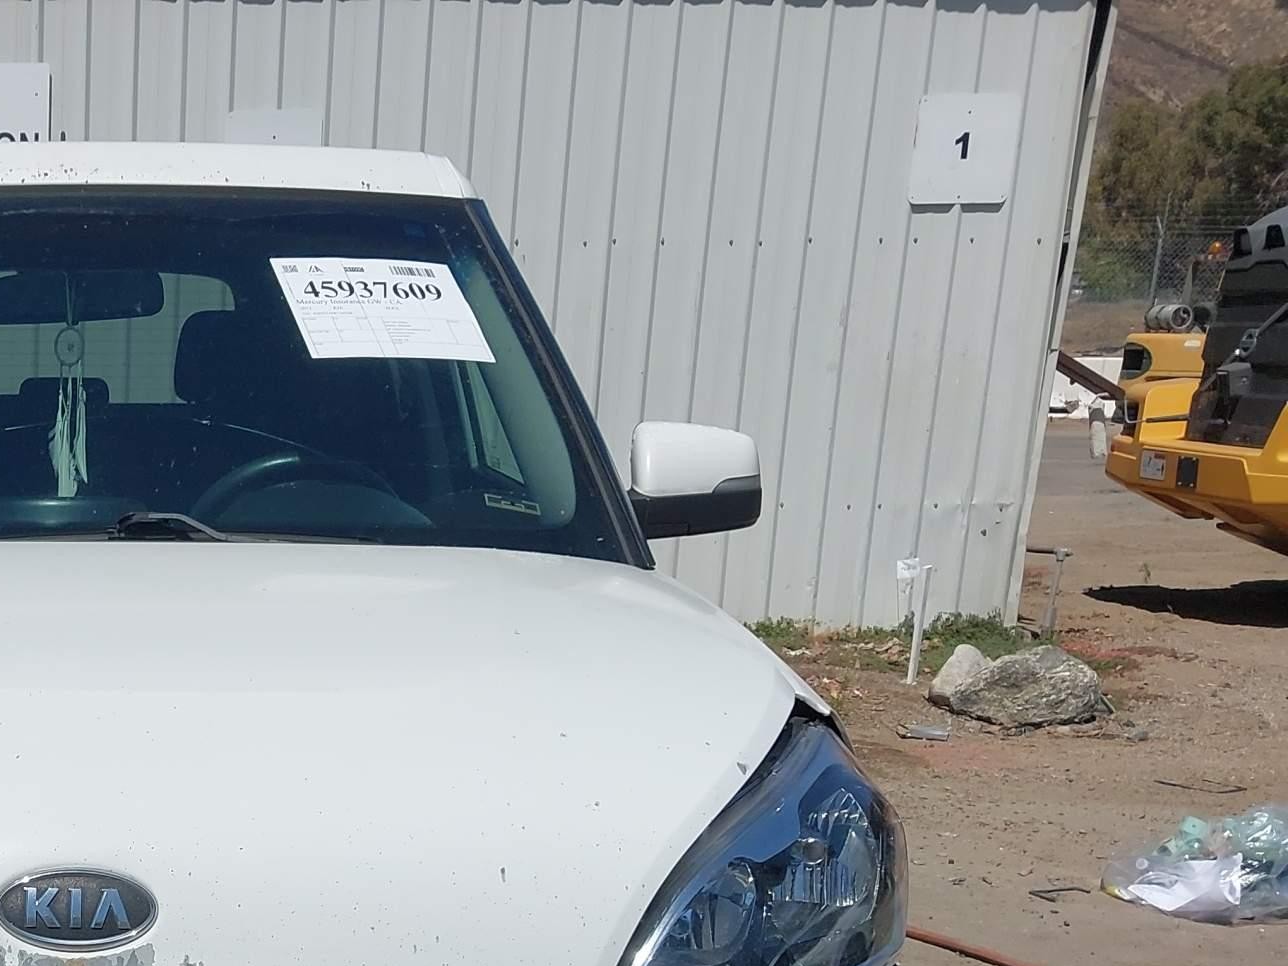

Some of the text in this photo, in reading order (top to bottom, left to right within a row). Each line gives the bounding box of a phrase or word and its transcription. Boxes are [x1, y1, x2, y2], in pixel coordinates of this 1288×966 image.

[955, 132, 970, 159] 1
[303, 280, 443, 301] 45937609
[24, 886, 132, 929] KIA
